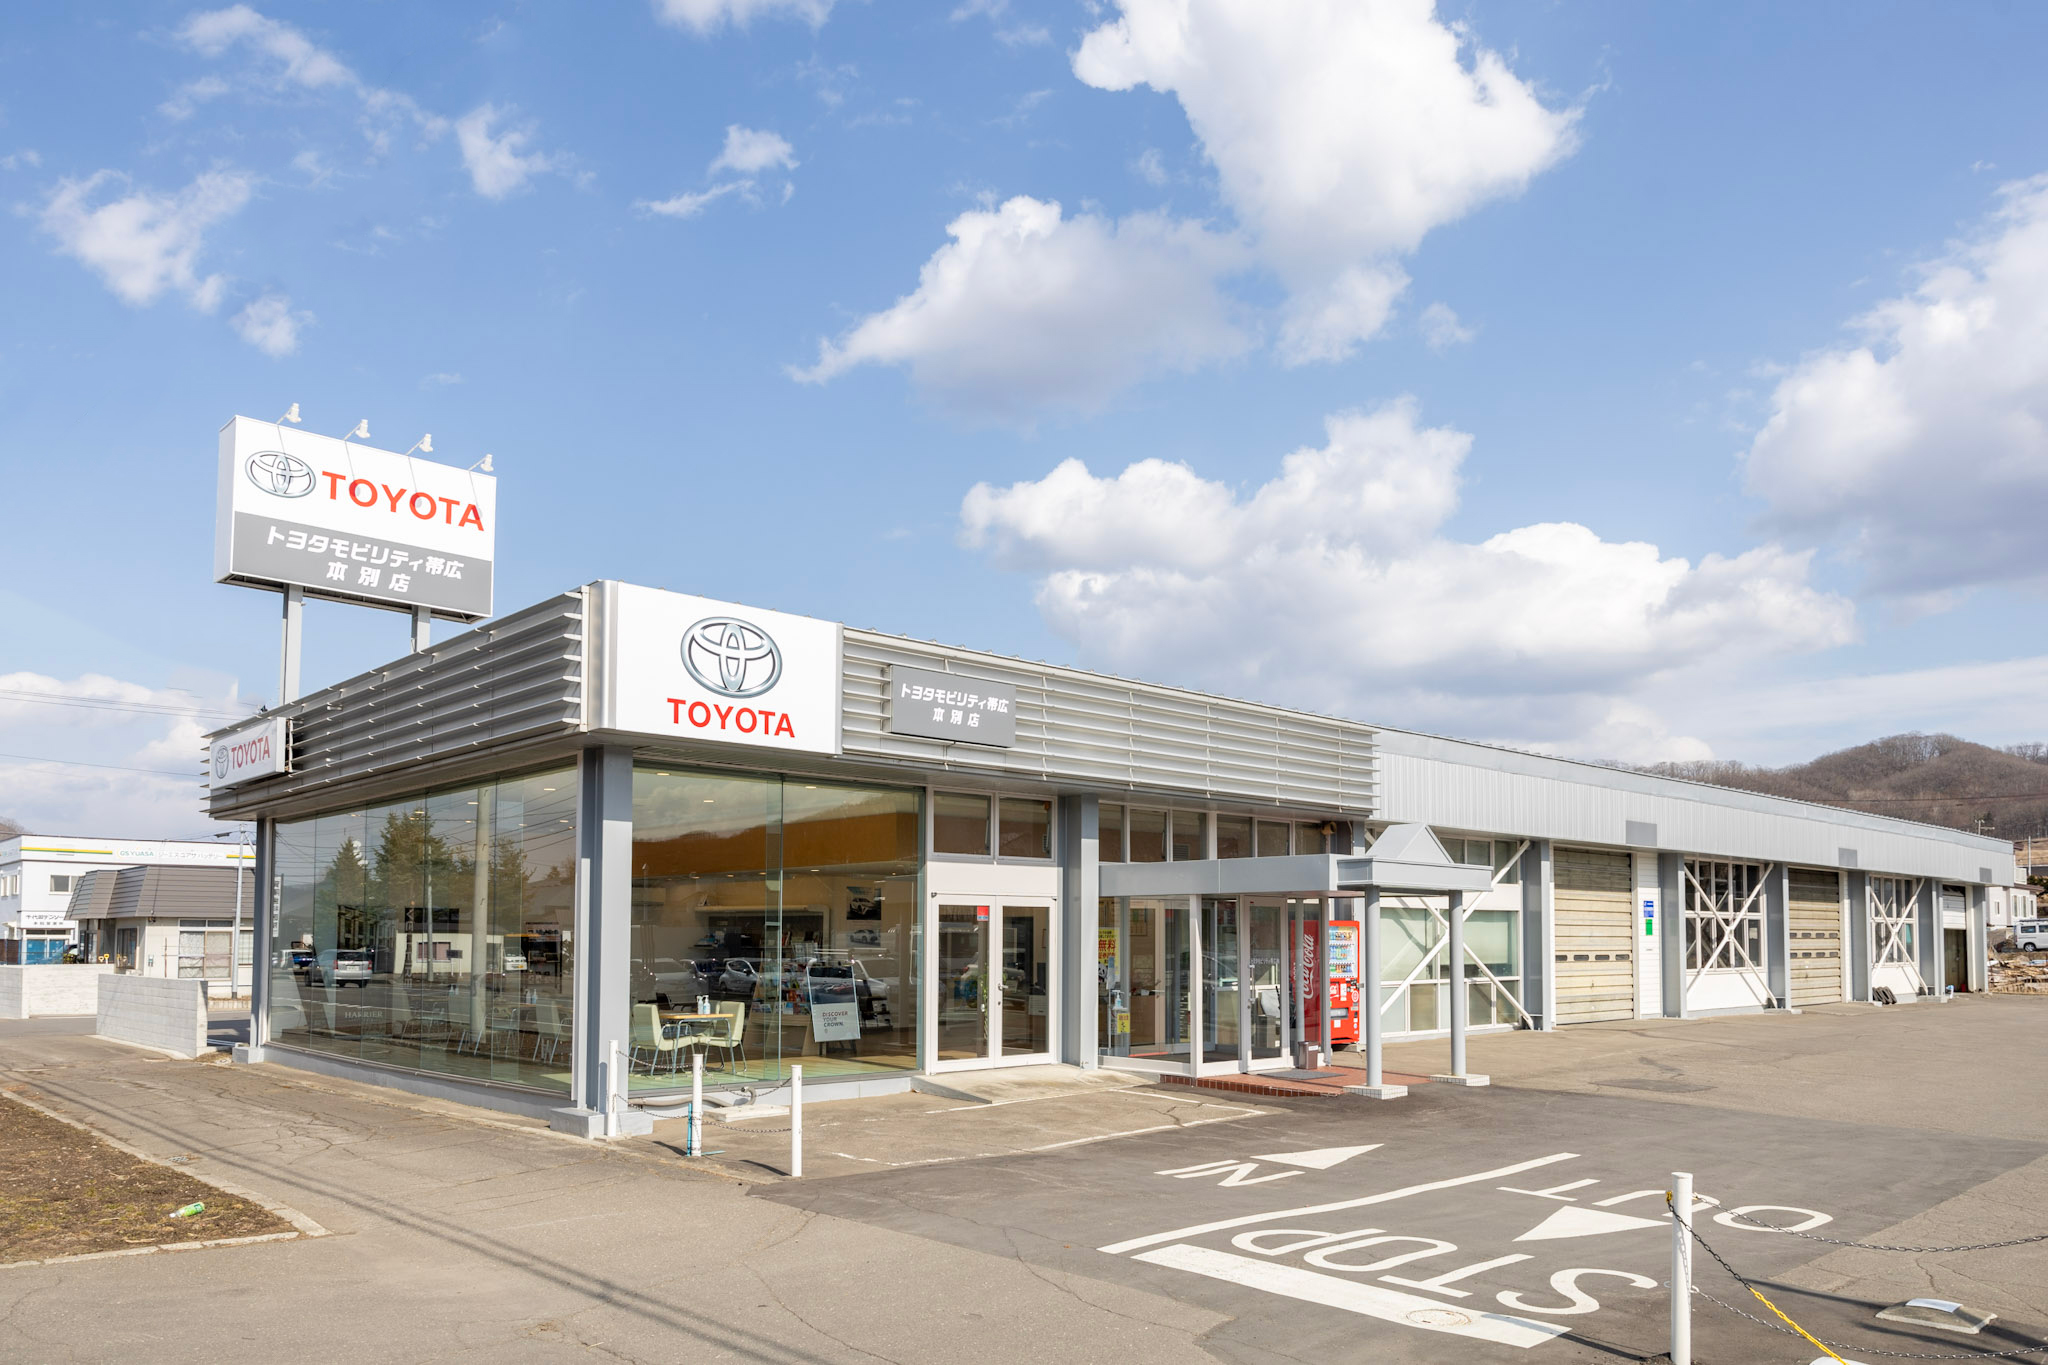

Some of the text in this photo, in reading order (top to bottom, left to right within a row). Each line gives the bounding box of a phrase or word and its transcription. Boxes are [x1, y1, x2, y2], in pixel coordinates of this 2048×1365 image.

[322, 470, 485, 532] TOYOTA
[267, 525, 465, 580] トヨタモビリティ帯広
[667, 697, 796, 738] TOYOTA
[901, 683, 1008, 714] トヨタモビリティ帯広
[231, 735, 271, 770] TOYOTA
[1303, 933, 1315, 999] CocaCola
[1153, 1159, 1306, 1187] IN
[1495, 1178, 1834, 1233] OUT
[1231, 1228, 1658, 1315] STOP
